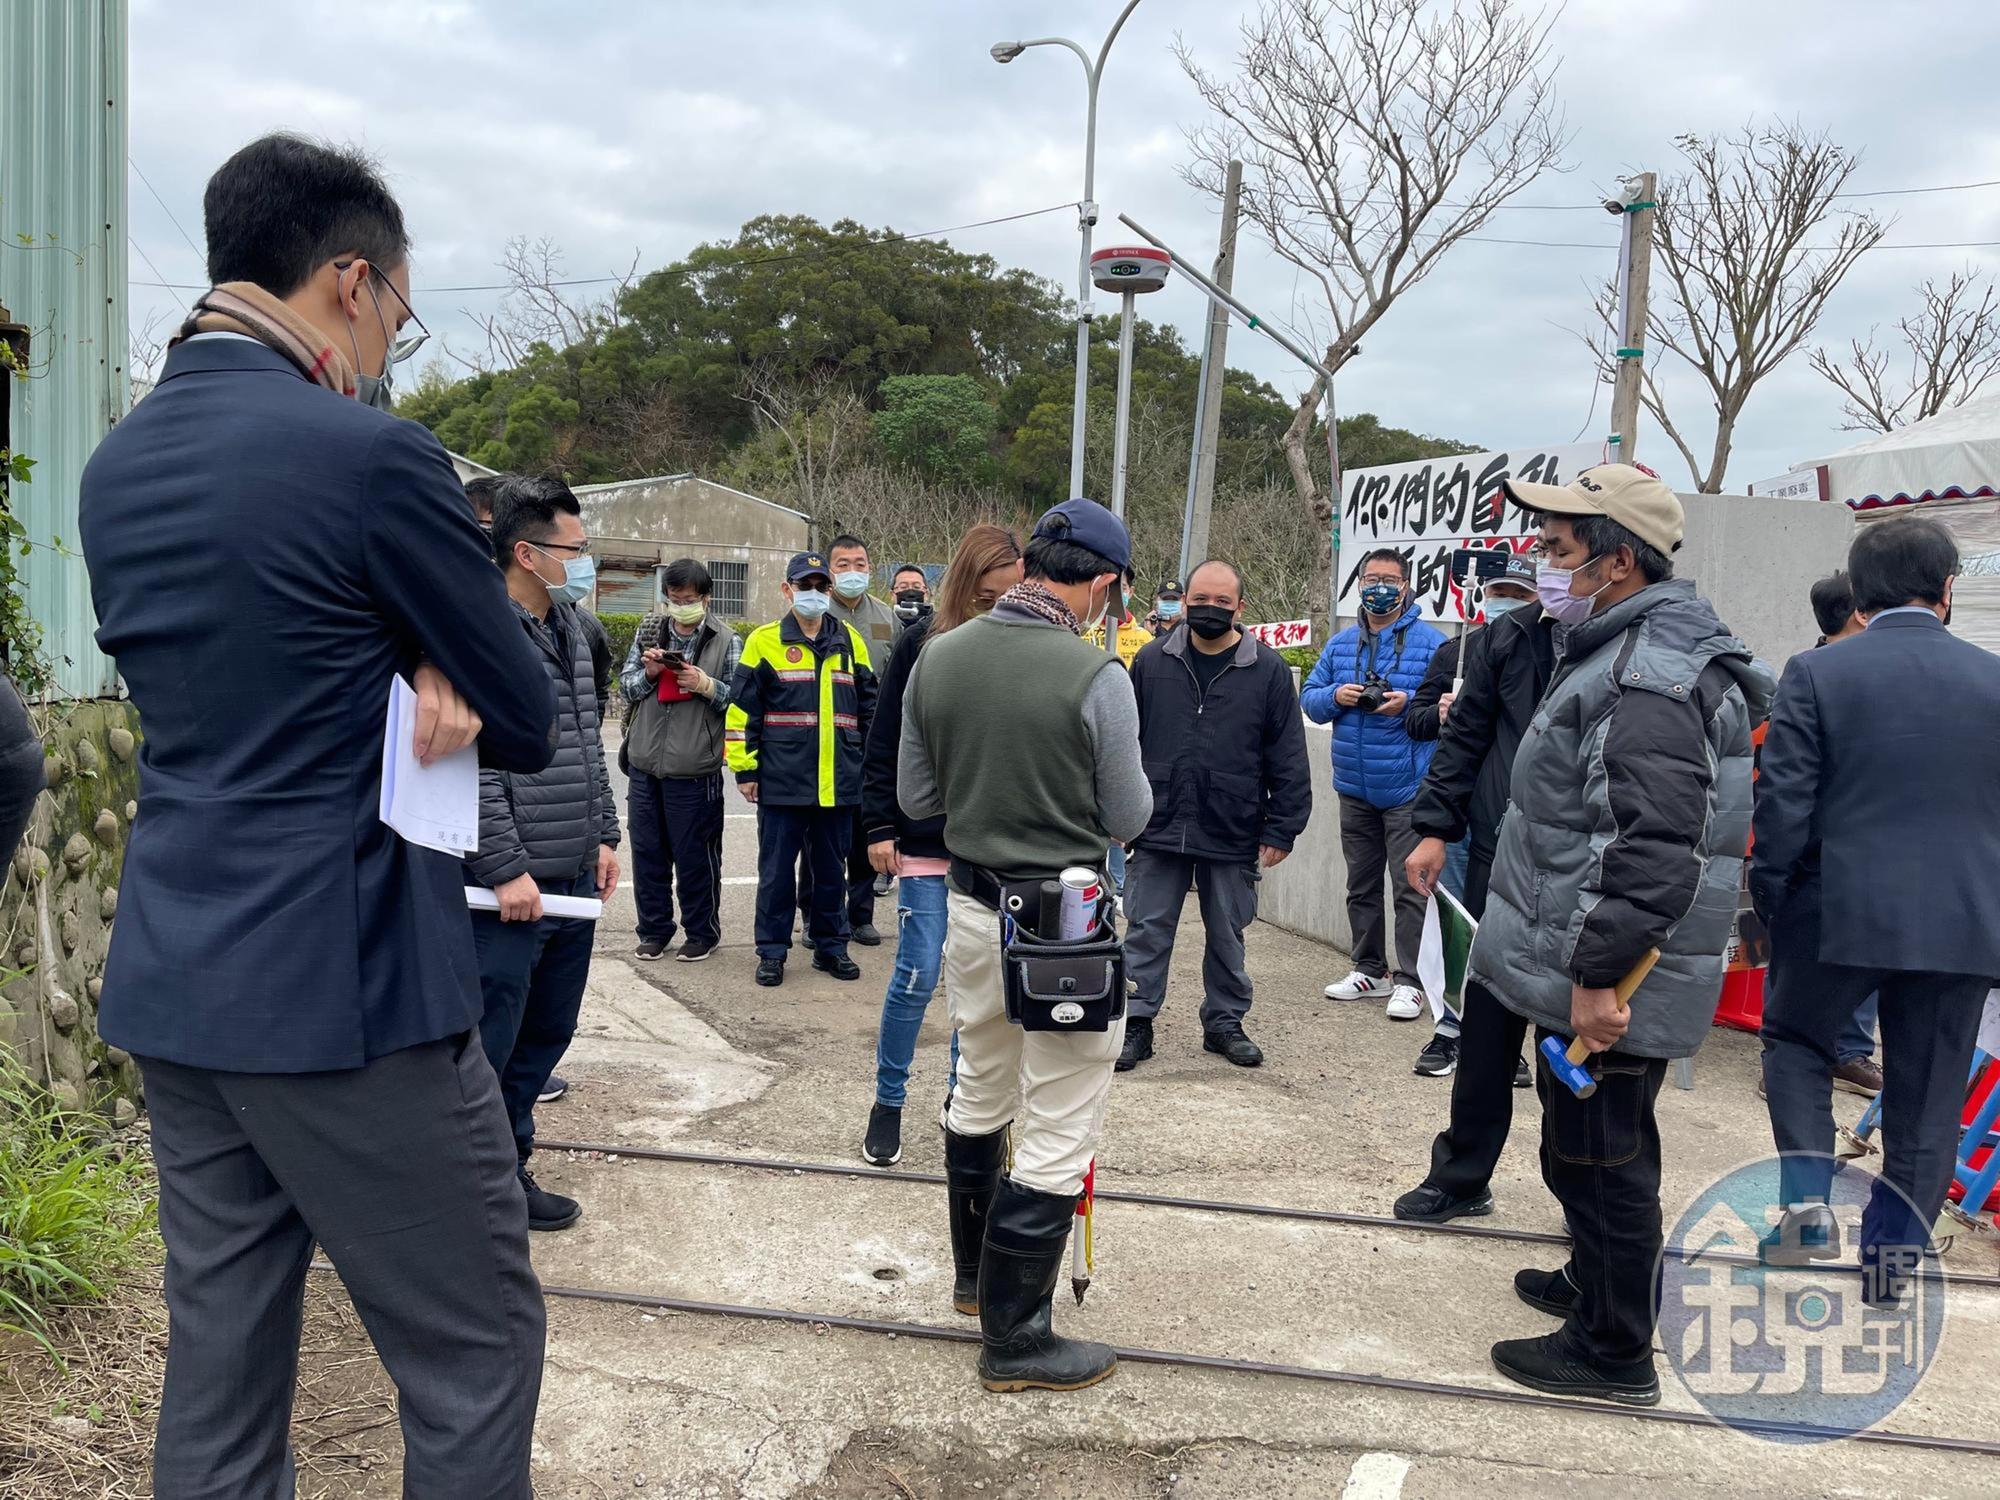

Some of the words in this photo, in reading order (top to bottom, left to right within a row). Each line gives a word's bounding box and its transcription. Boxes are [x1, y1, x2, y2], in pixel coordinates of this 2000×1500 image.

[1346, 453, 1559, 538] 你們的自私
